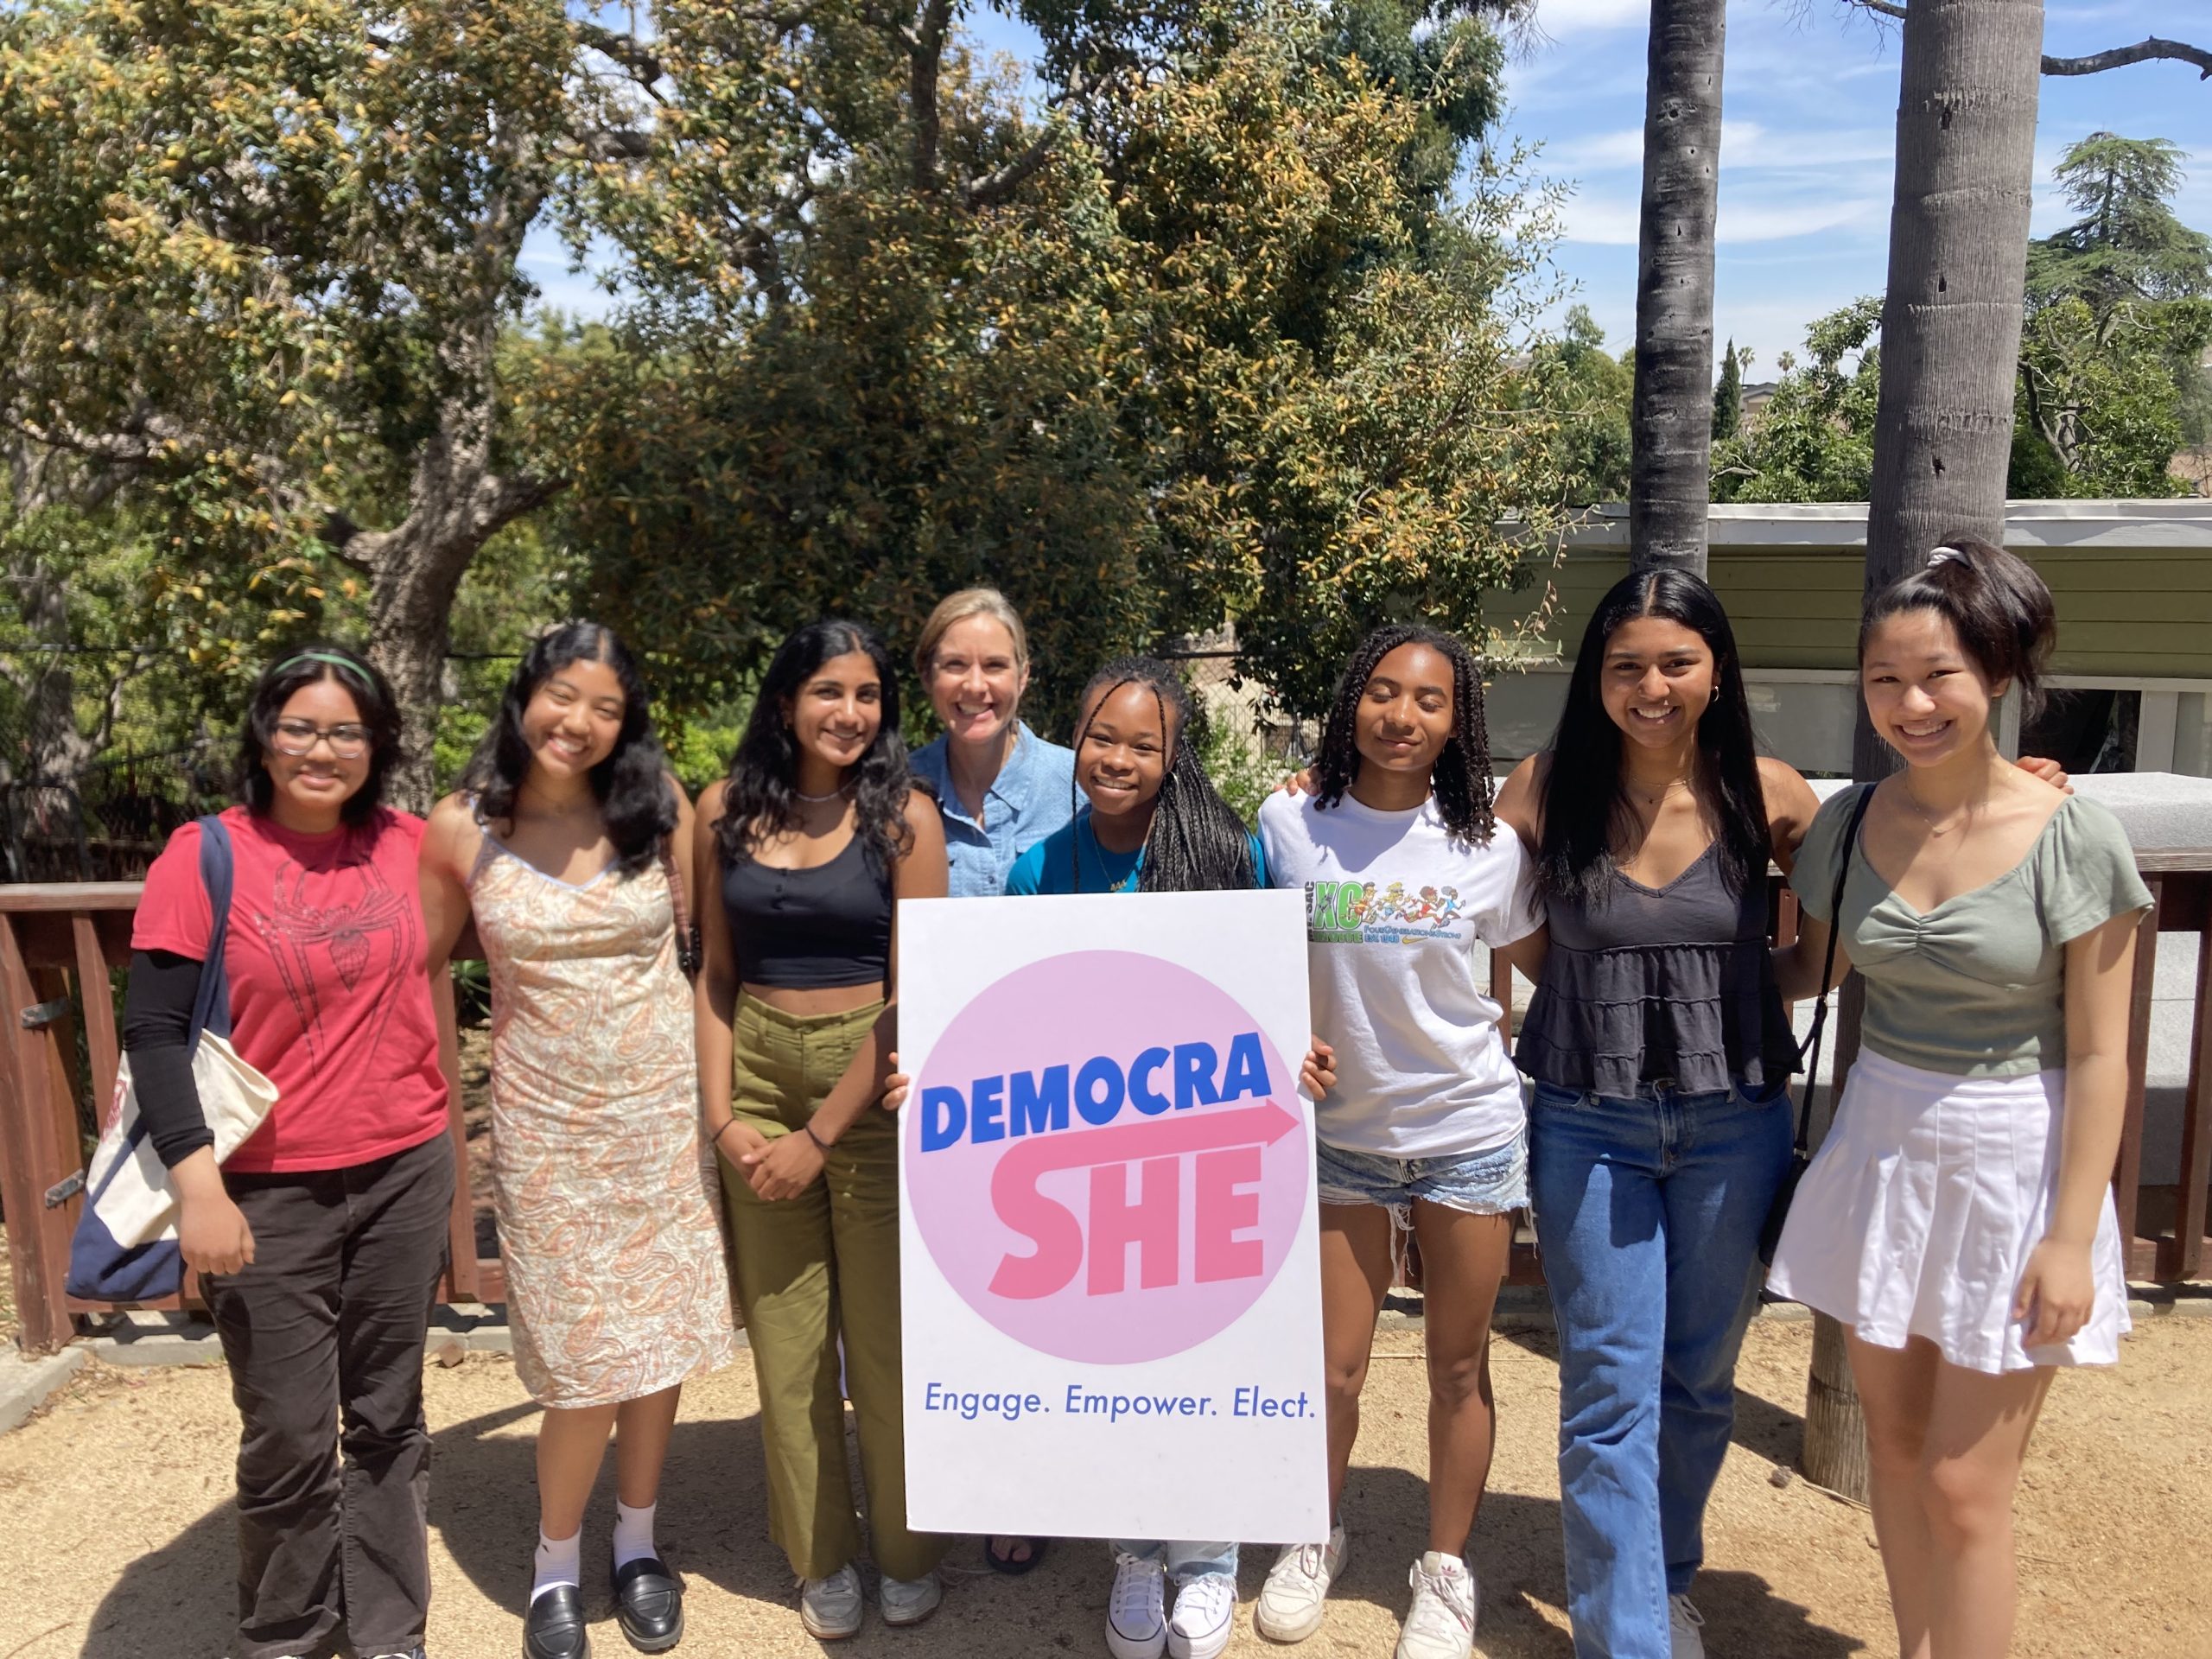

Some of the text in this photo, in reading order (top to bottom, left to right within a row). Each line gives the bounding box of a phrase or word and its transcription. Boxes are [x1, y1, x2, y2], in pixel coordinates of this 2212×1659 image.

[1313, 881, 1363, 931] XC
[1313, 931, 1363, 944] INVITE
[920, 1032, 1273, 1153] DEMOCRA
[988, 1130, 1265, 1300] SHE
[925, 1382, 1315, 1423] Engage. Empower. Elect.
